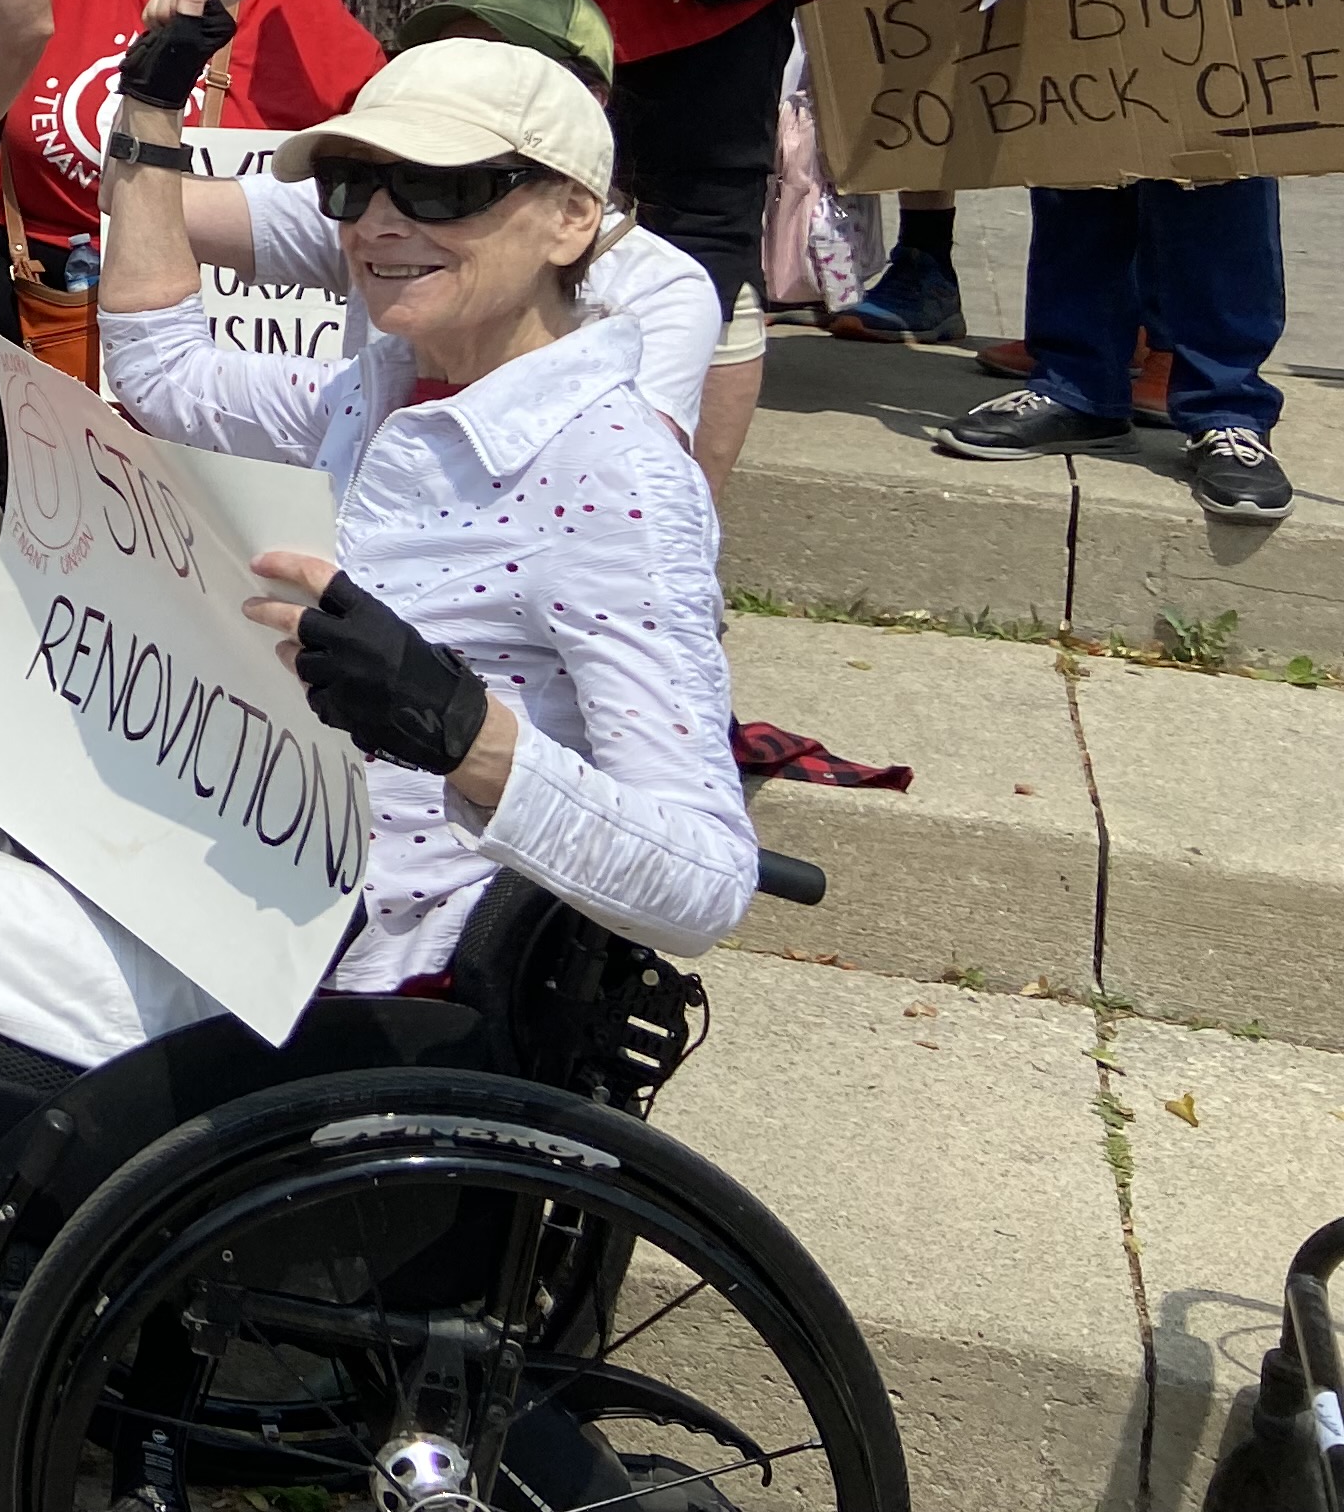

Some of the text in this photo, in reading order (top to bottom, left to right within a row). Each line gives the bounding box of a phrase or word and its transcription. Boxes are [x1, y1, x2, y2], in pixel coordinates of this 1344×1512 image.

[865, 0, 930, 64] IS
[32, 92, 100, 188] TENAN
[871, 49, 1344, 149] SO BACK OFF
[9, 509, 95, 575] TENANT UNION
[84, 426, 206, 594] STOP
[26, 594, 368, 896] RENOVICTIONS
